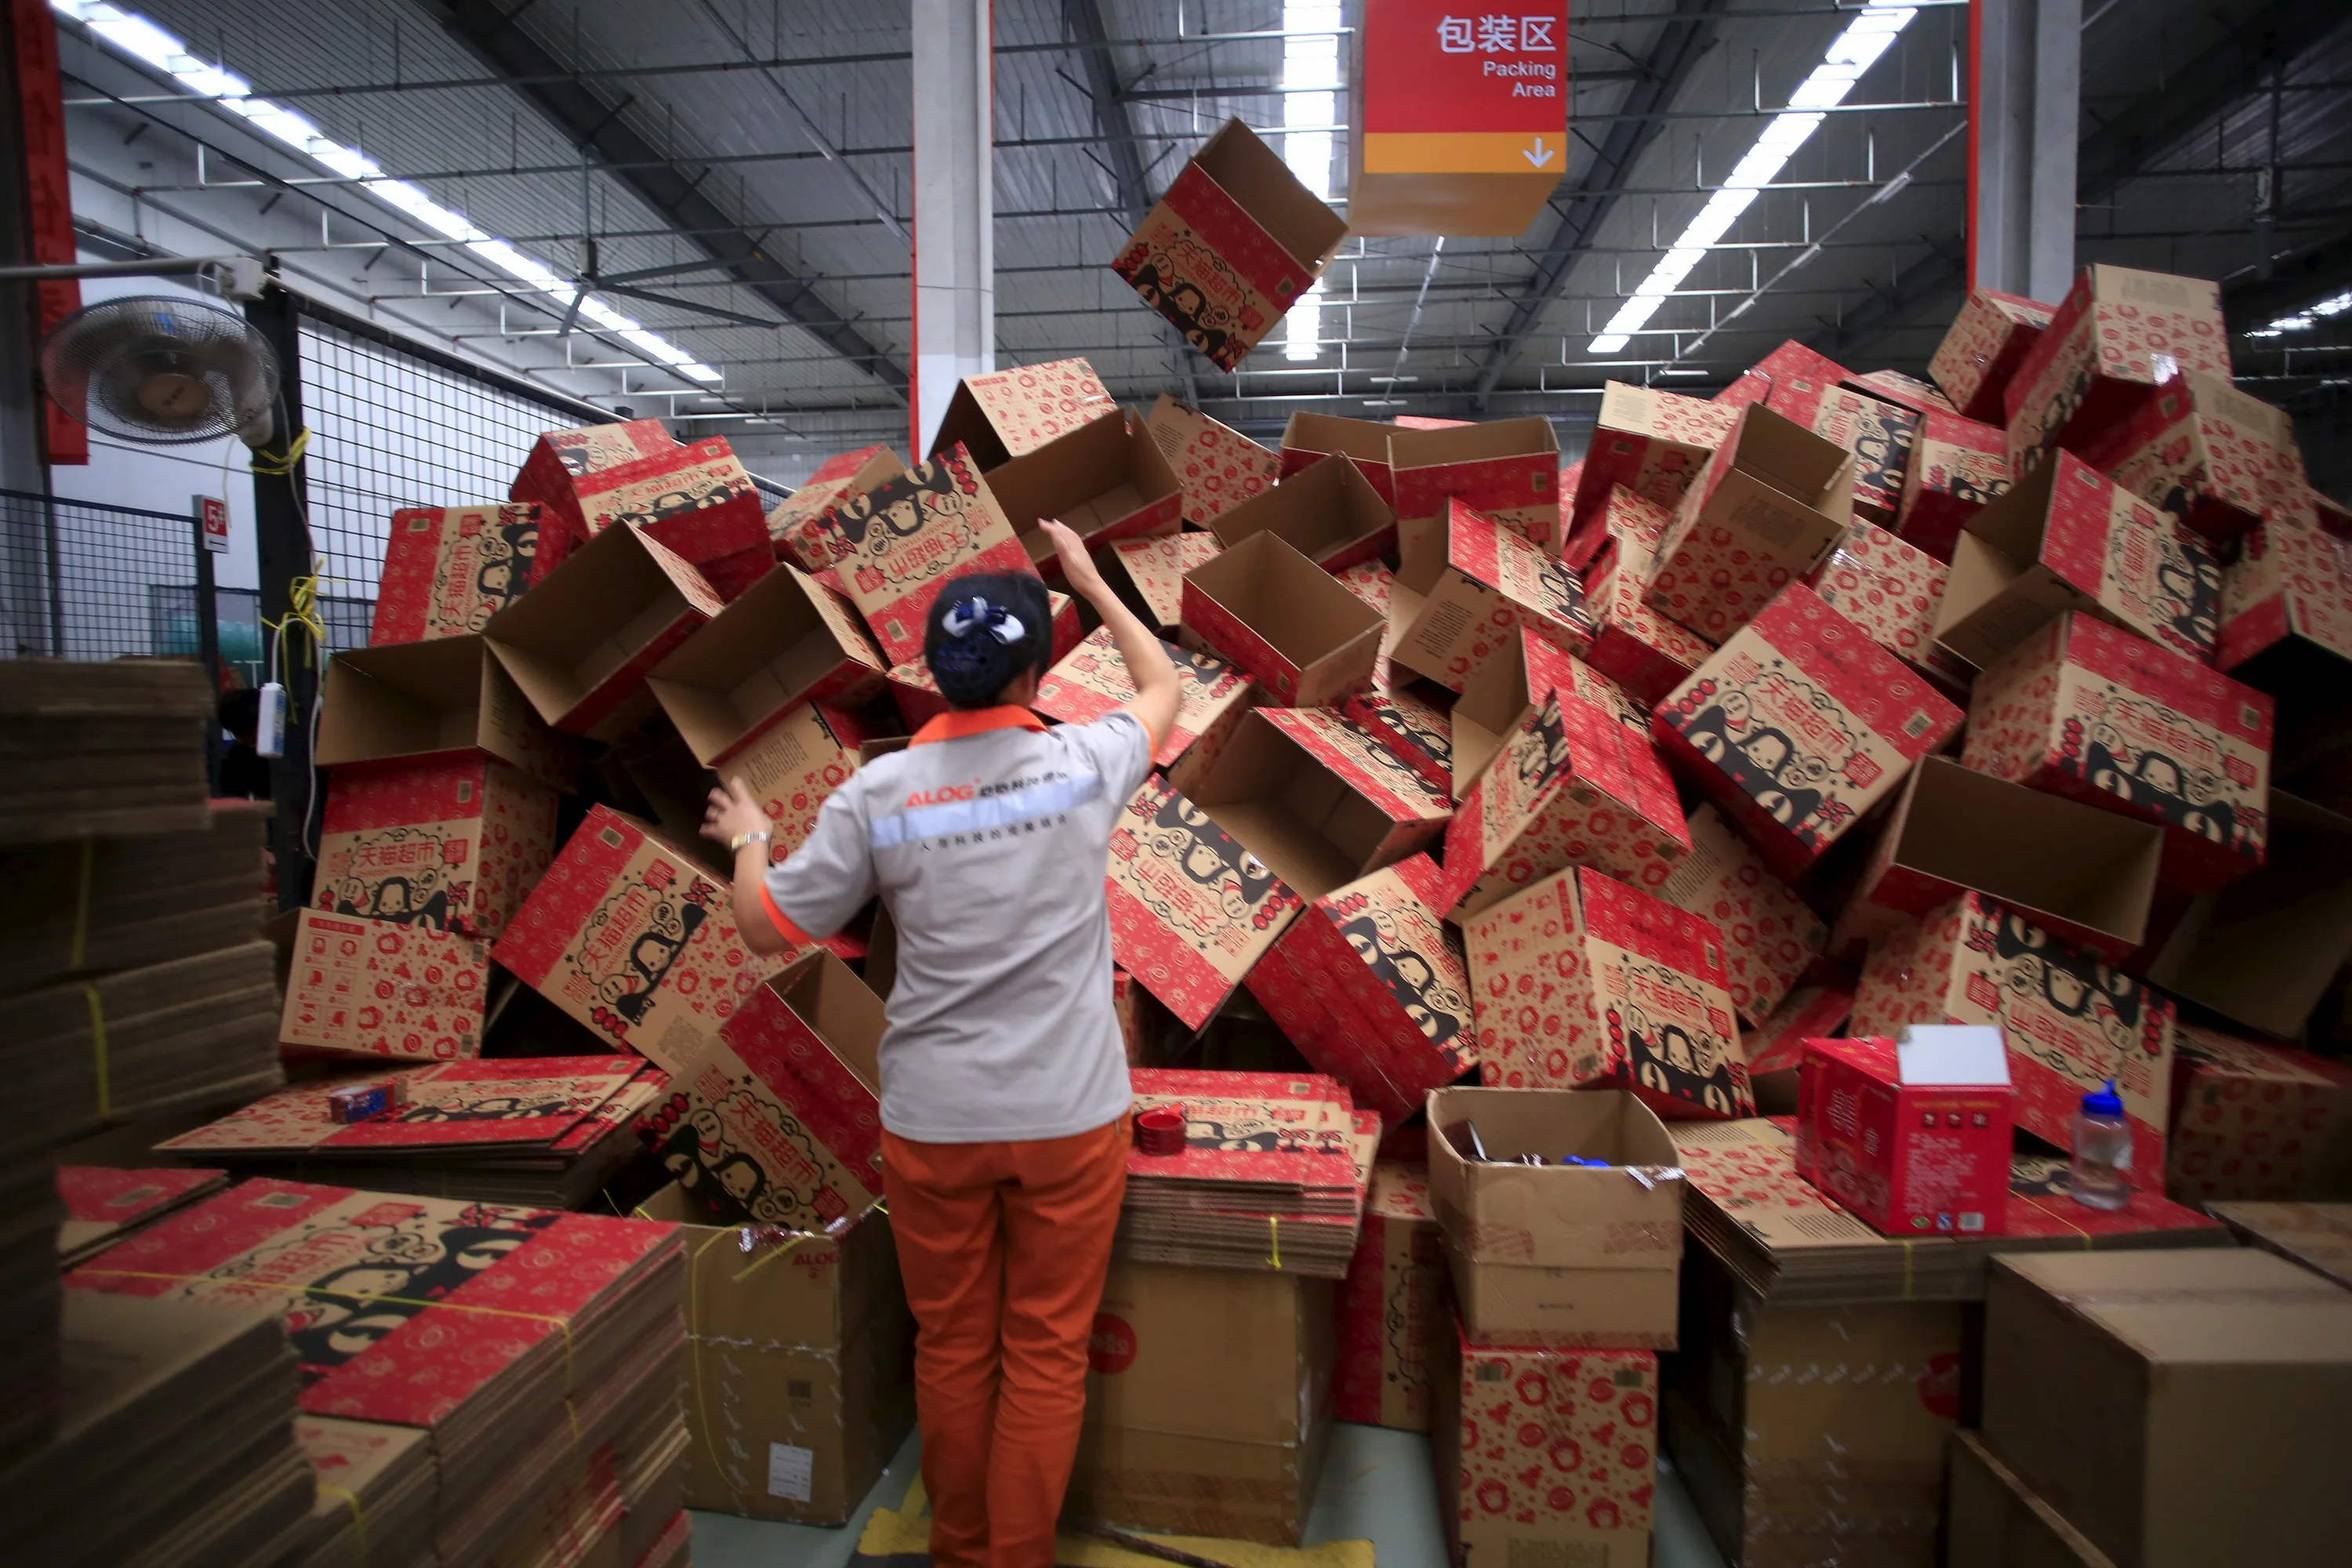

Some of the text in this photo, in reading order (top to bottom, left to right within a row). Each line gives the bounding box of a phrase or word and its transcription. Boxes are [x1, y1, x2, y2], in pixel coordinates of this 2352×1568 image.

[1436, 14, 1557, 53] 包装区
[1483, 60, 1556, 80] Packing
[1512, 82, 1556, 97] Area
[1177, 242, 1241, 306] 天猫超市
[888, 524, 967, 577] 天猫超市
[1759, 676, 1851, 754] 天猫超市
[2114, 702, 2215, 762] 天猫超市
[904, 784, 975, 808] ALOG
[360, 842, 436, 867] 天猫超市
[1136, 860, 1217, 933] 天猫超市
[583, 888, 647, 971] 天猫超市
[1633, 973, 1705, 1020] 天猫超市
[2009, 1004, 2112, 1077] 天猫超市
[728, 1095, 818, 1186] 天猫超市
